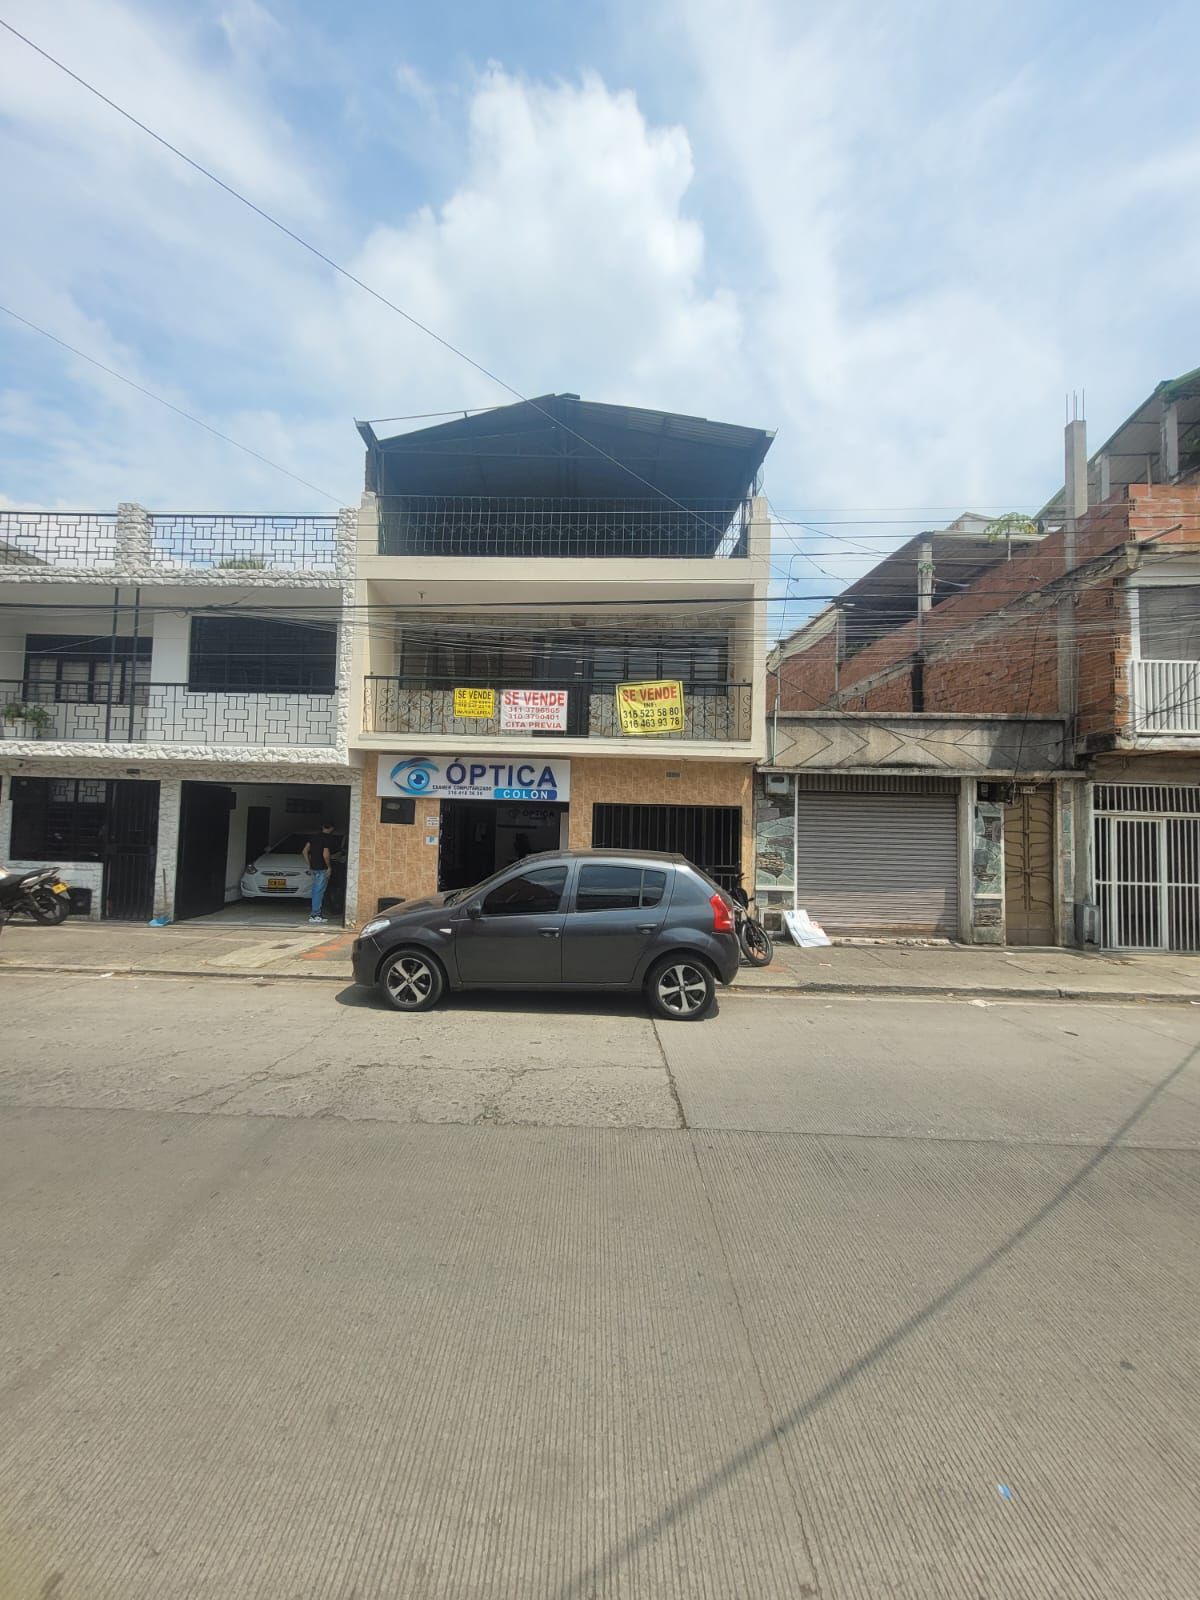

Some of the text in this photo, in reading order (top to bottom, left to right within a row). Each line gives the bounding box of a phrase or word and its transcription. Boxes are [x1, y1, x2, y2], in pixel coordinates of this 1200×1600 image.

[458, 690, 492, 699] SE VENDE
[504, 691, 565, 706] SE VENDE
[623, 686, 677, 702] SE VENDE
[640, 708, 655, 718] 523
[657, 708, 667, 717] 58
[669, 706, 679, 716] 80
[529, 721, 562, 729] PREVIA
[623, 717, 680, 728] 316 463 93 78
[446, 758, 557, 788] ÓPTICA
[503, 790, 549, 800] COLON
